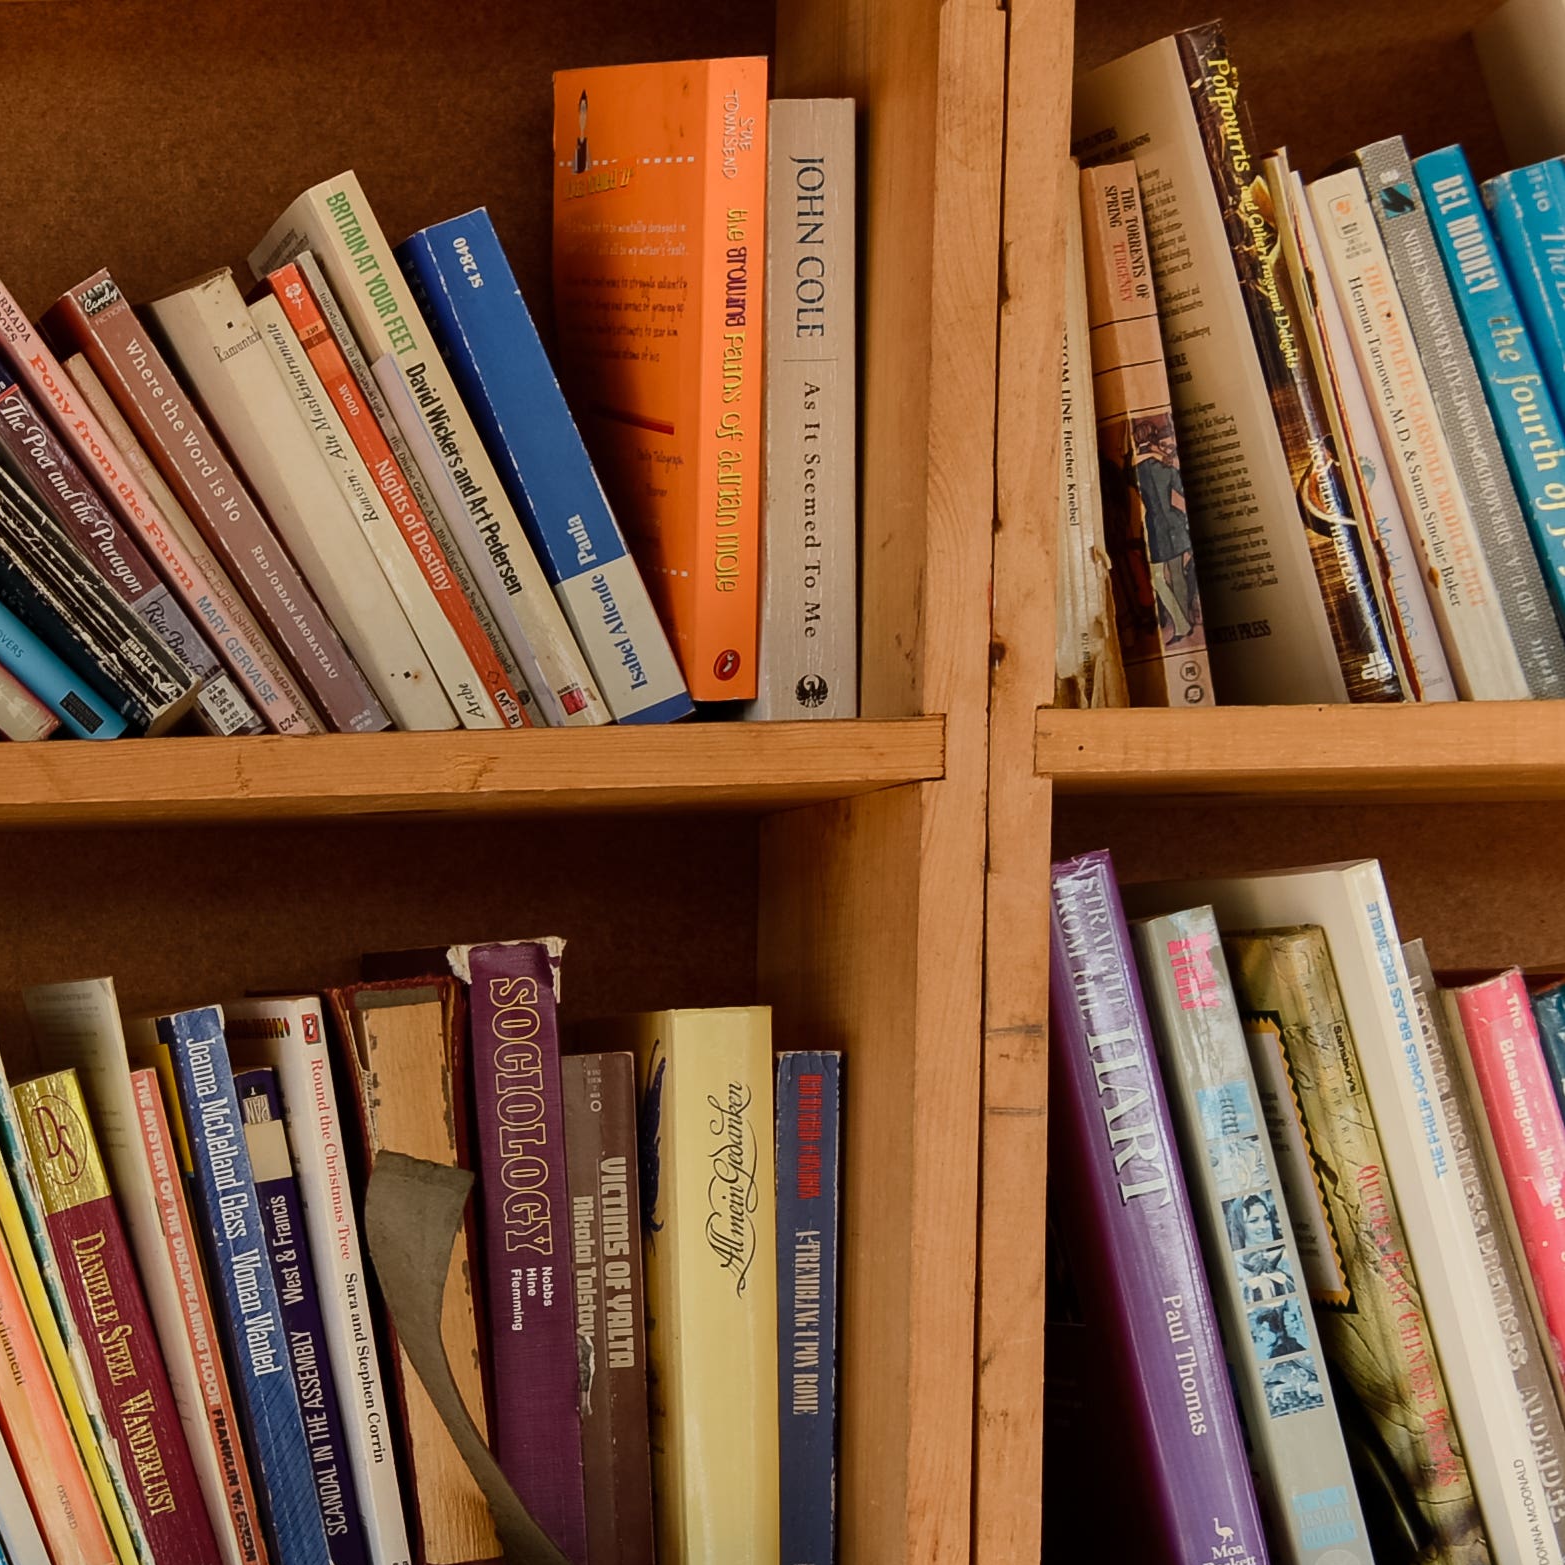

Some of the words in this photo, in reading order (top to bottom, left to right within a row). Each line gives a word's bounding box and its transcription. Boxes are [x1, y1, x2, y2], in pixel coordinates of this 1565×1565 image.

[326, 191, 371, 261] BRITAIN
[788, 155, 826, 243] JOHN
[1433, 173, 1467, 218] DEL
[1452, 219, 1501, 295] MOONEY
[353, 248, 374, 280] AT
[362, 271, 394, 315] YOUR
[795, 253, 825, 338] COLE
[379, 308, 419, 355] FEET
[567, 515, 598, 566] Paula
[590, 574, 629, 648] Allende
[600, 636, 645, 692] Isabel
[490, 976, 553, 1255] SOCIOLOGY
[1162, 1295, 1185, 1340] Paul
[72, 1231, 112, 1327] DANIELLE
[99, 1322, 137, 1385] STEEL
[122, 1391, 175, 1516] WANDERLUST
[1170, 1343, 1208, 1435] Thomas
